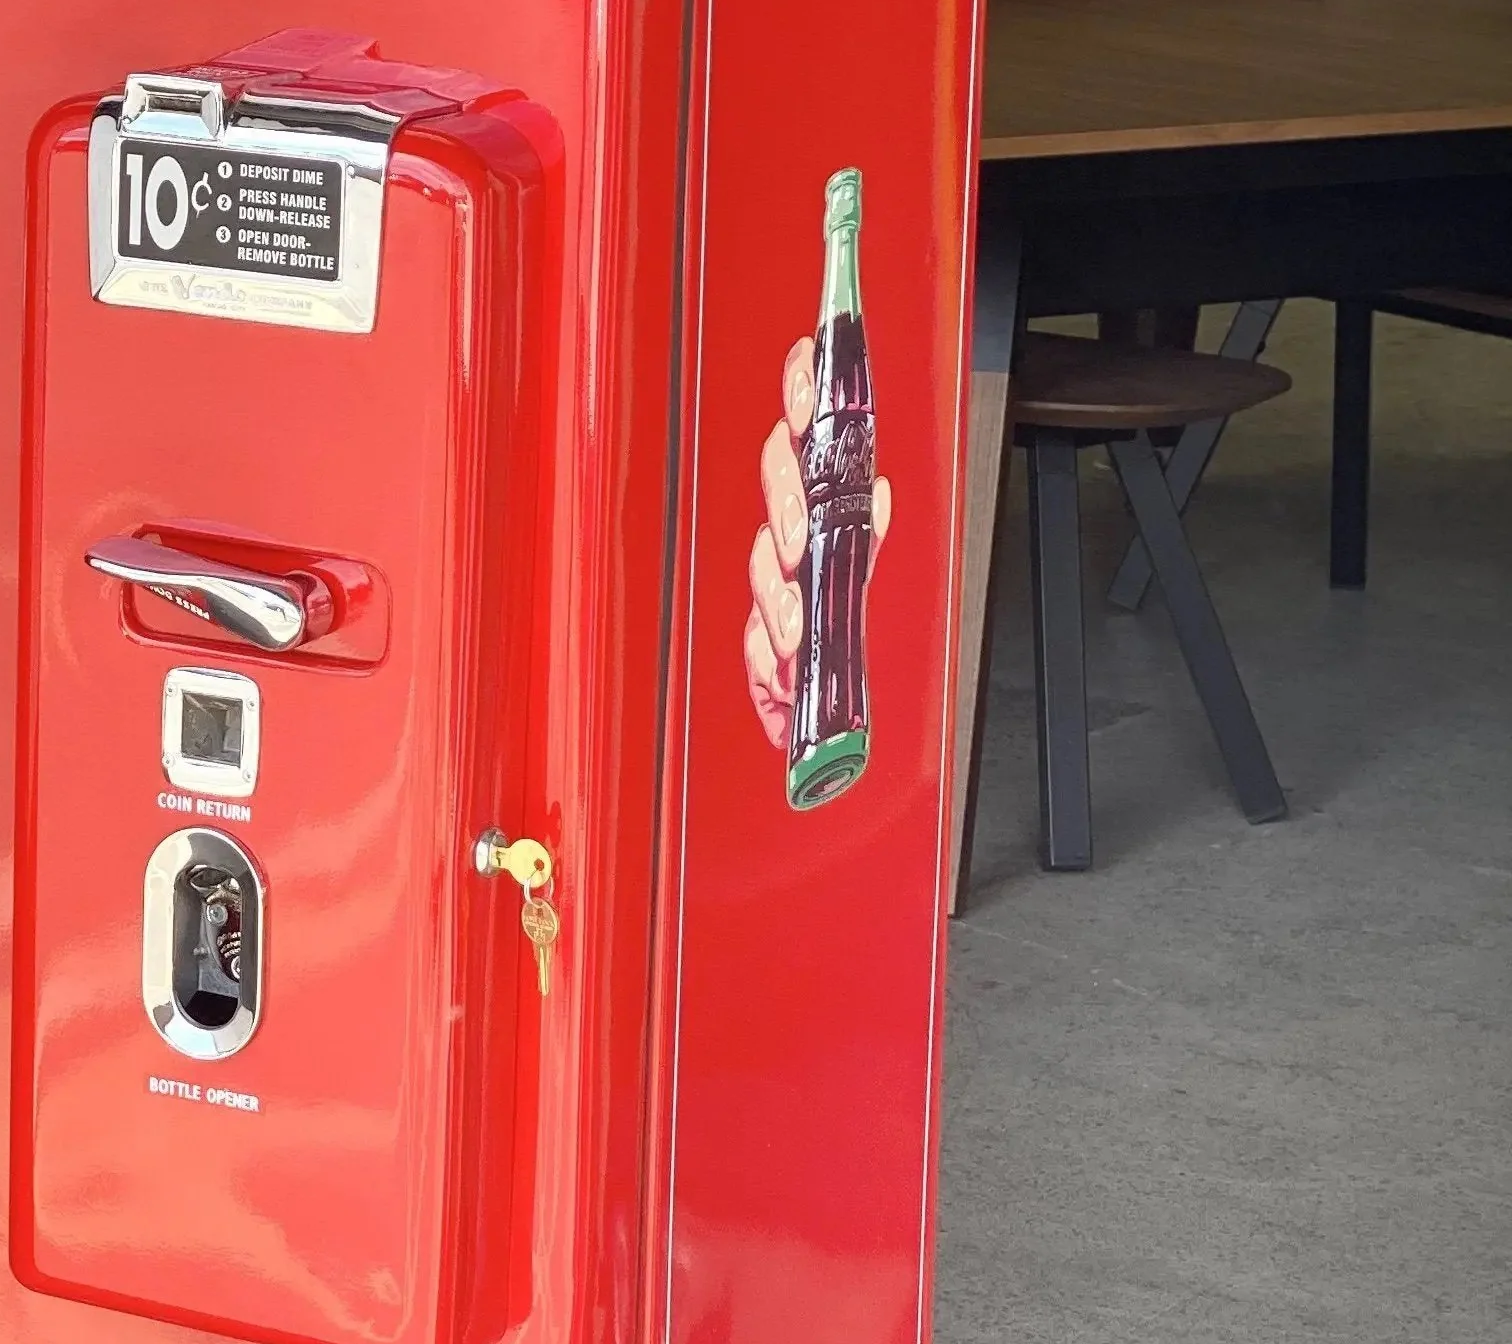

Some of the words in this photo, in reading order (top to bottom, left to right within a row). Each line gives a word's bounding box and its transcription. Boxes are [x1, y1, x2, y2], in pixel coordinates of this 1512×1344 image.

[240, 164, 289, 181] DEPOSIT
[292, 170, 324, 186] DIME
[239, 188, 277, 205] PRESS
[280, 193, 327, 210] HANDLE
[238, 206, 331, 229] DOWN-RELEASE
[238, 229, 269, 246] OPEN
[237, 246, 286, 265] REMOVE
[290, 253, 335, 271] BOTTLE
[157, 792, 192, 813] COIN
[196, 798, 251, 822] RETURN
[149, 1076, 201, 1101] BOTTLE
[206, 1087, 260, 1112] OPENER
